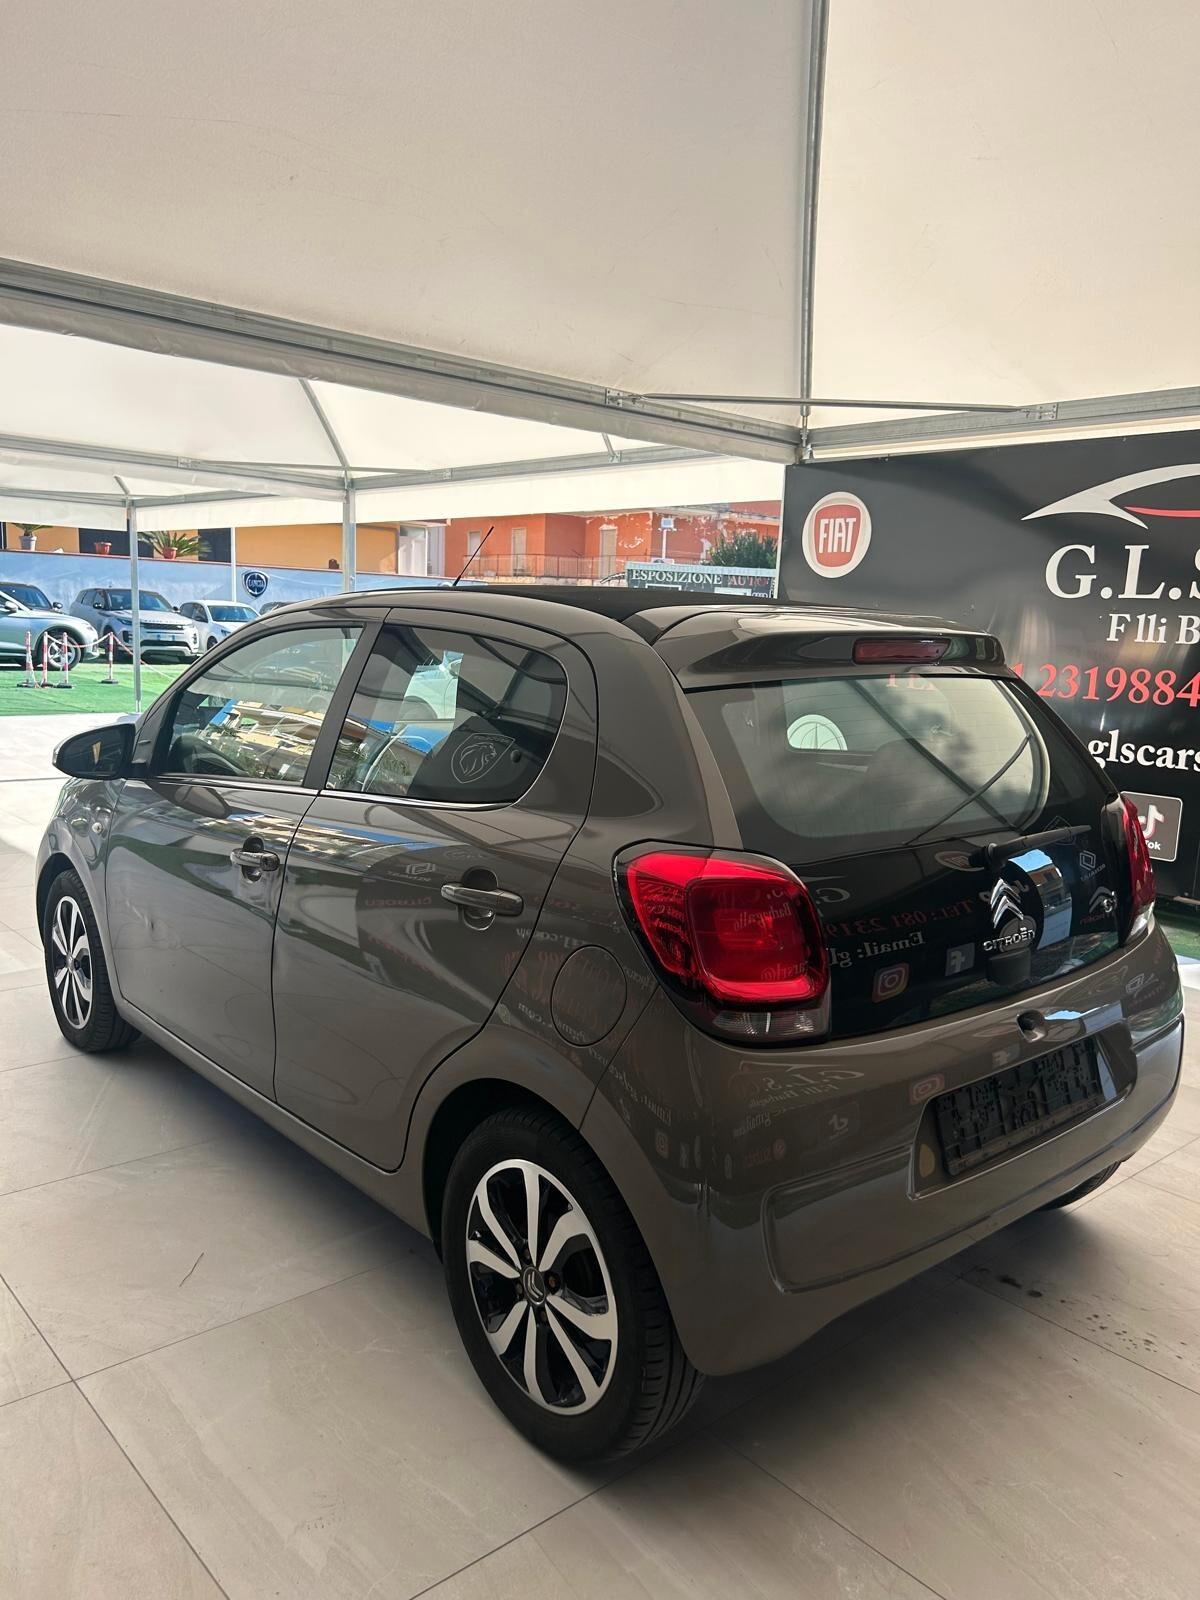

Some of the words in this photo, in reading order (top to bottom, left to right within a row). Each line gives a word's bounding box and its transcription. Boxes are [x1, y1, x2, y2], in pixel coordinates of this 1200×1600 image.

[818, 517, 857, 553] FIAT
[631, 569, 723, 585] ESPOSIZIONE
[983, 927, 1036, 951] CITROËN
